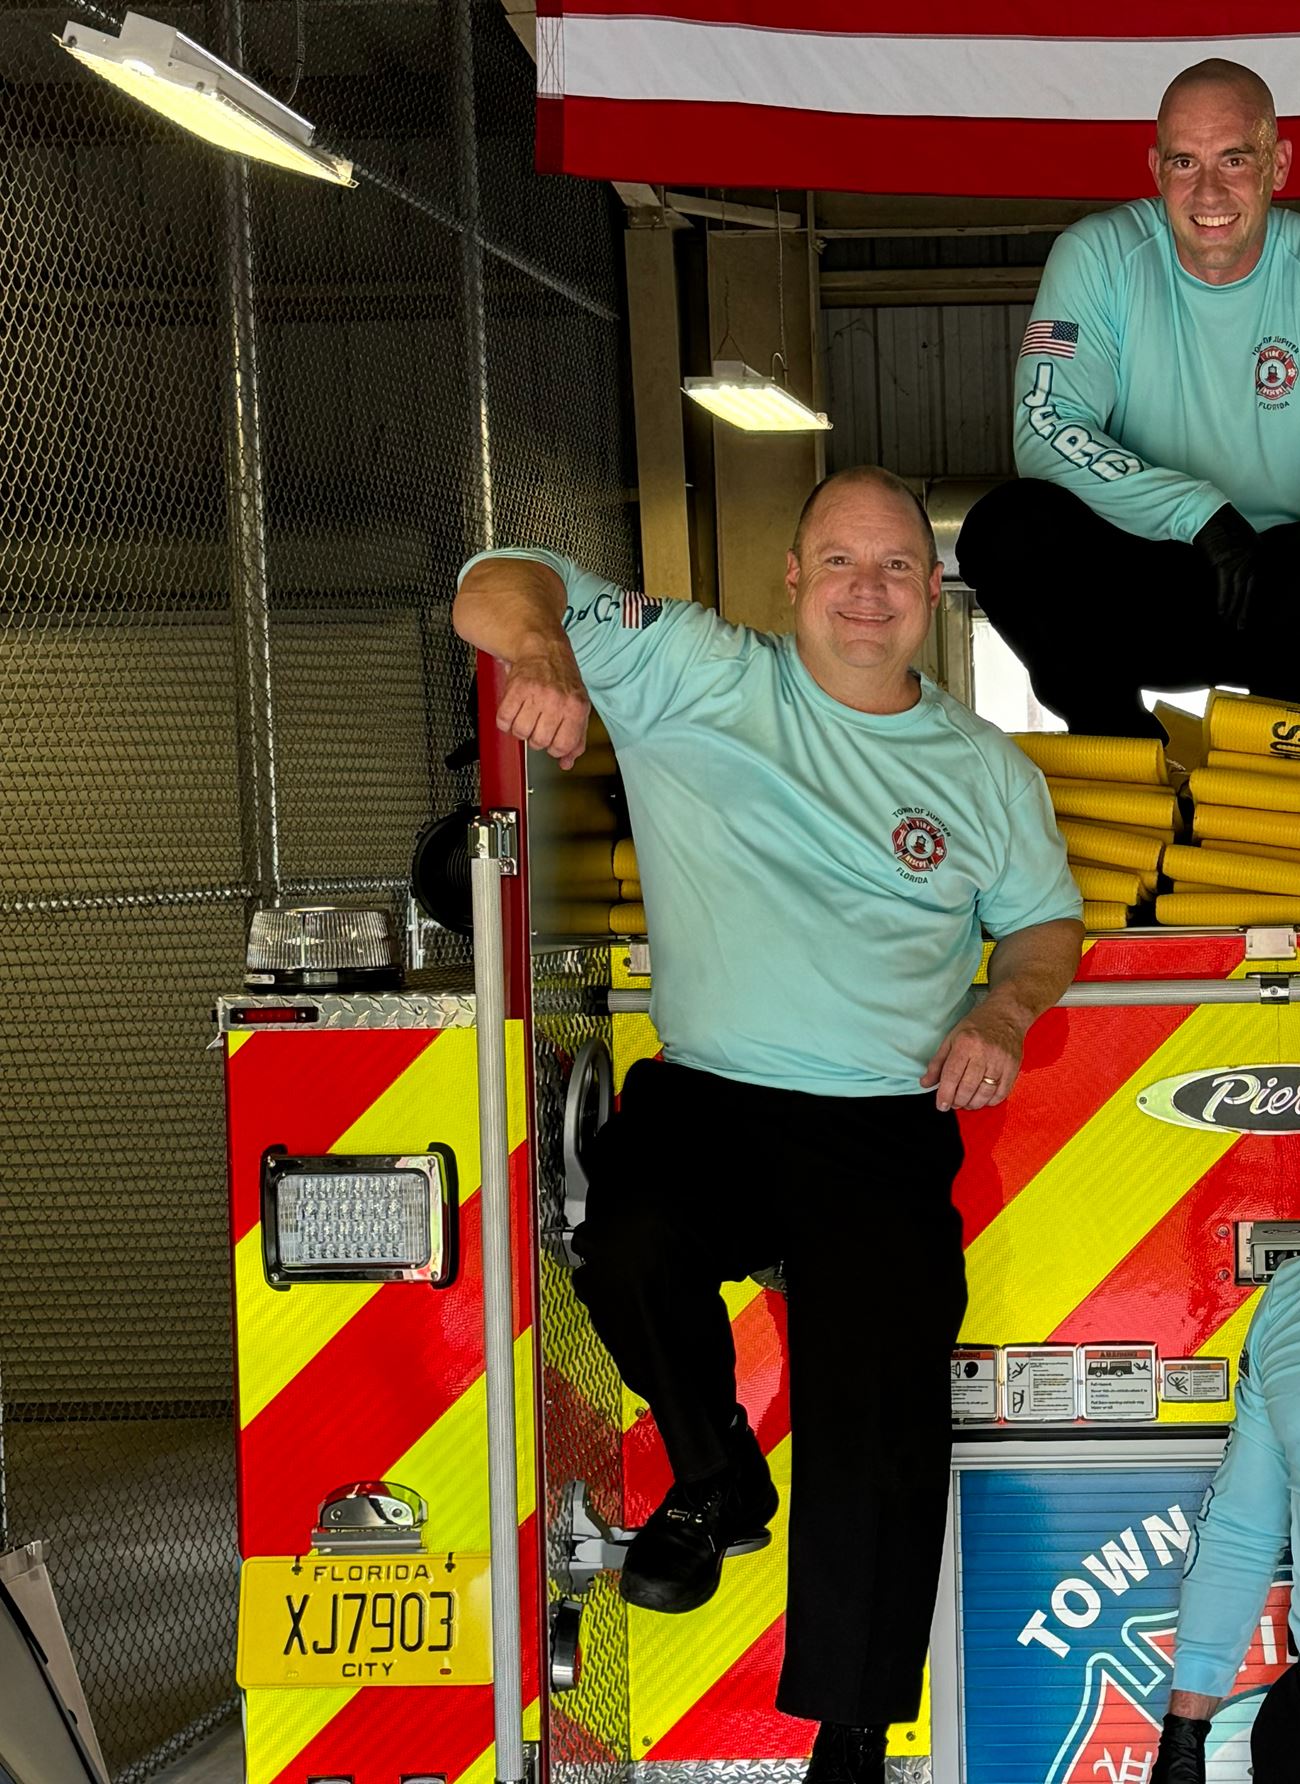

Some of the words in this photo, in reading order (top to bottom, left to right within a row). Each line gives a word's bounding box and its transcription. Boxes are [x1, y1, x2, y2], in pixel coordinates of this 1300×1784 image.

[1258, 401, 1290, 410] FLORIDA
[892, 807, 913, 818] TOWN
[926, 811, 951, 837] JUPITER
[896, 866, 928, 884] FLORIDA
[313, 1564, 430, 1582] FLORIDA
[1017, 1504, 1191, 1658] TOWN
[283, 1591, 454, 1656] XJ7903
[342, 1662, 394, 1678] CITY
